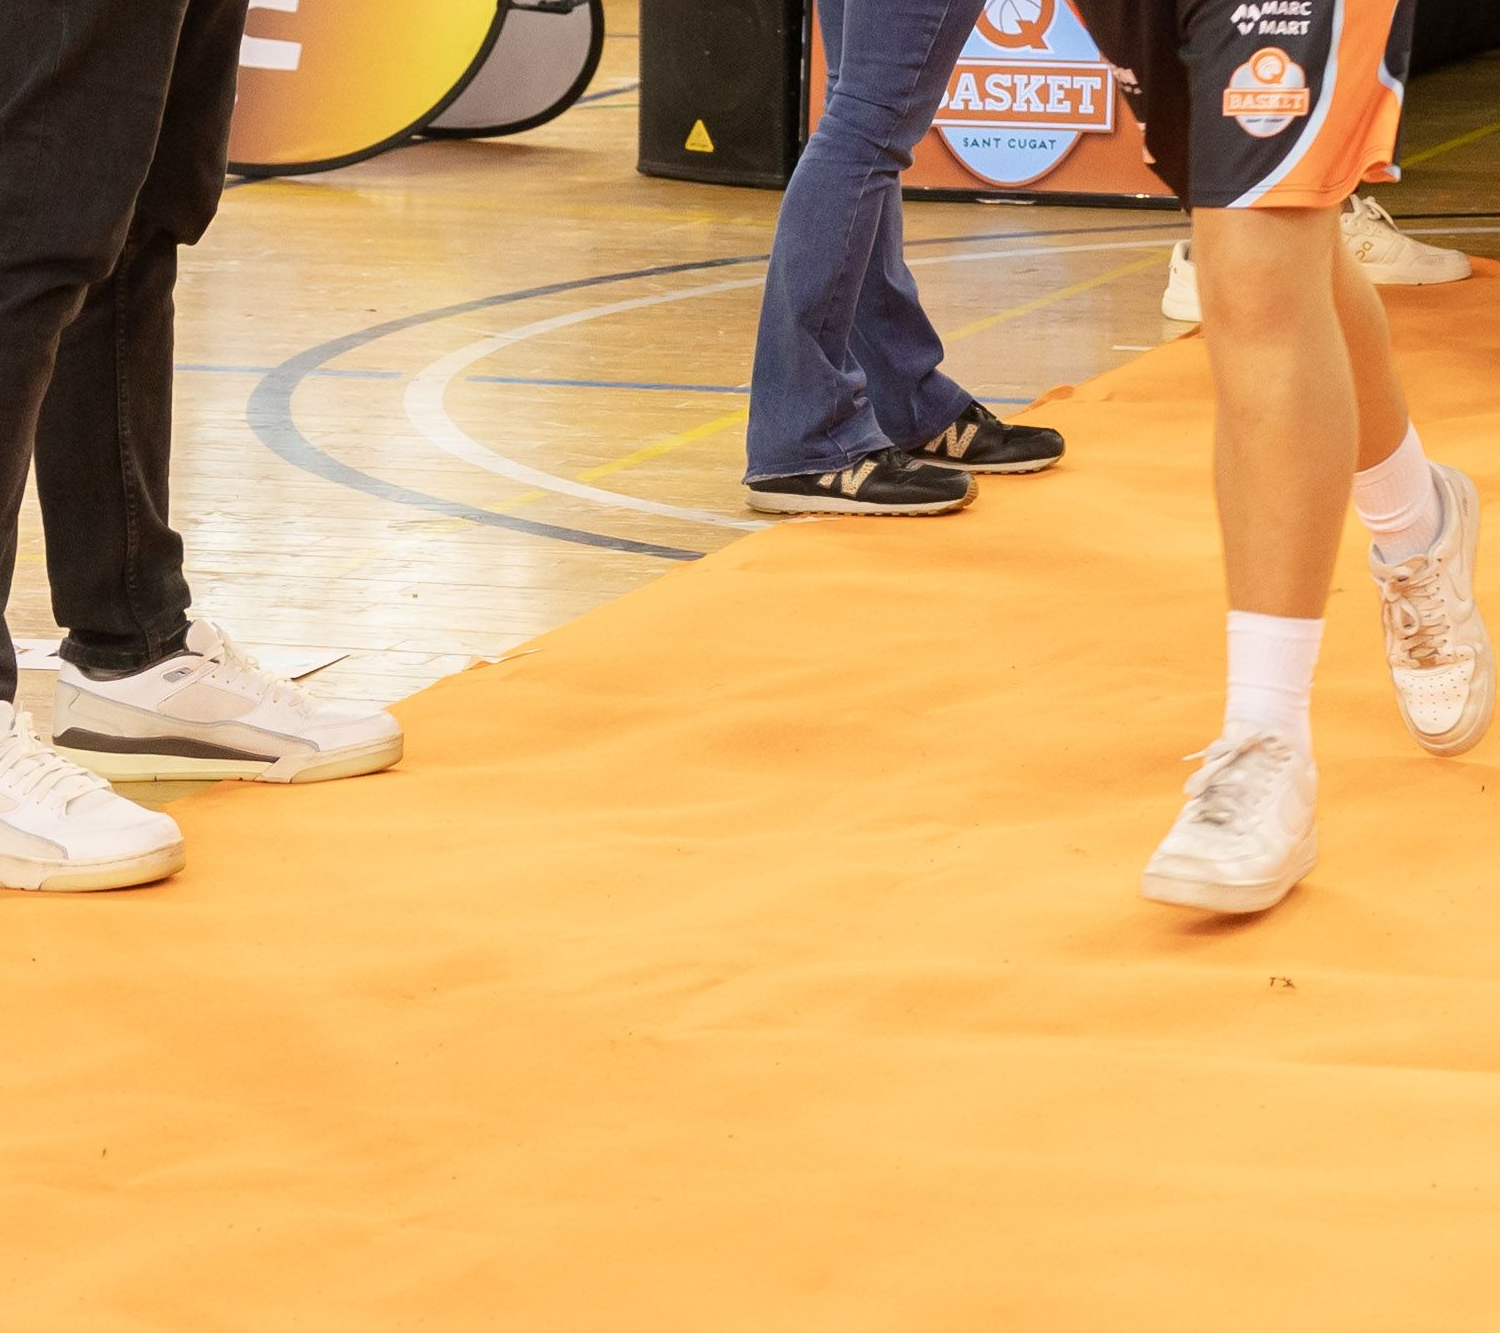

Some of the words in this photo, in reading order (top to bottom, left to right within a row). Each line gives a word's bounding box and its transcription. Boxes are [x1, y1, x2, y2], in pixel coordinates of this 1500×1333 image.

[1260, 0, 1312, 15] MARC
[1258, 20, 1312, 35] MART
[939, 73, 1102, 115] ASKET
[963, 137, 1002, 149] SANT
[1007, 138, 1057, 151] CUGAT
